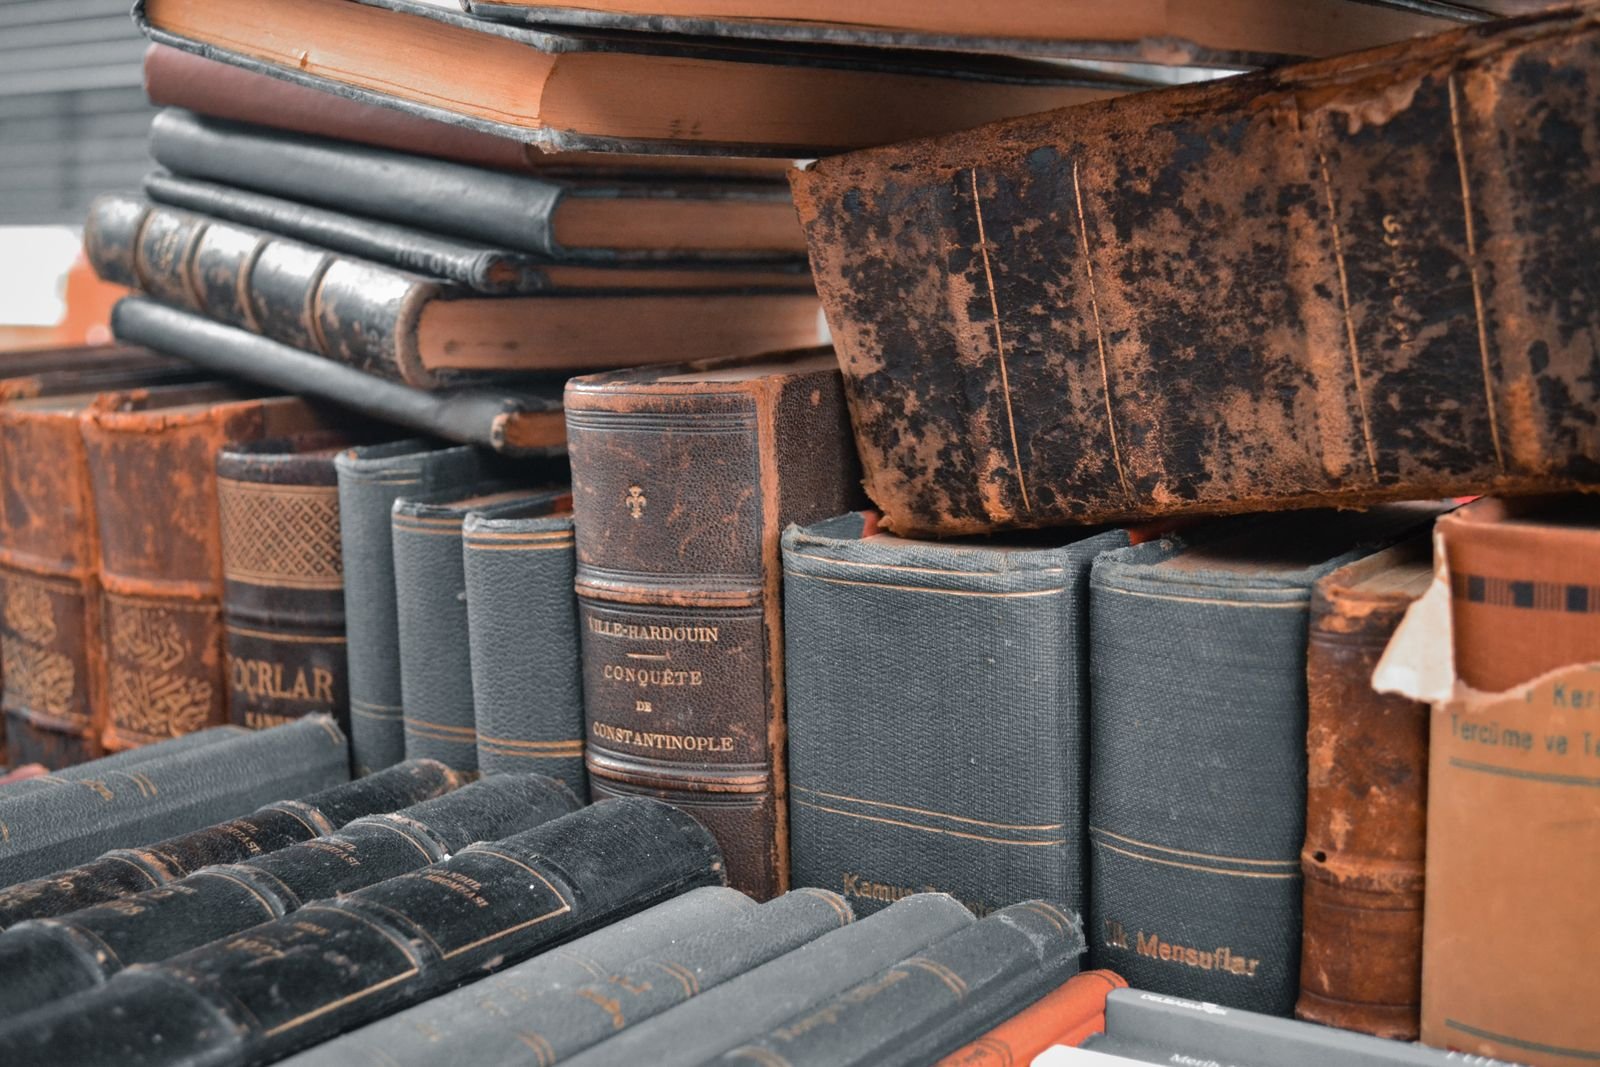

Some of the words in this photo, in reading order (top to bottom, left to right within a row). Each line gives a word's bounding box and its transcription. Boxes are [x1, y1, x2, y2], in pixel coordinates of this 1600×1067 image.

[604, 664, 703, 687] CONQUÊTE
[636, 700, 653, 713] DE
[592, 720, 735, 751] CONSTANTINOPLE
[1545, 734, 1568, 756] ve
